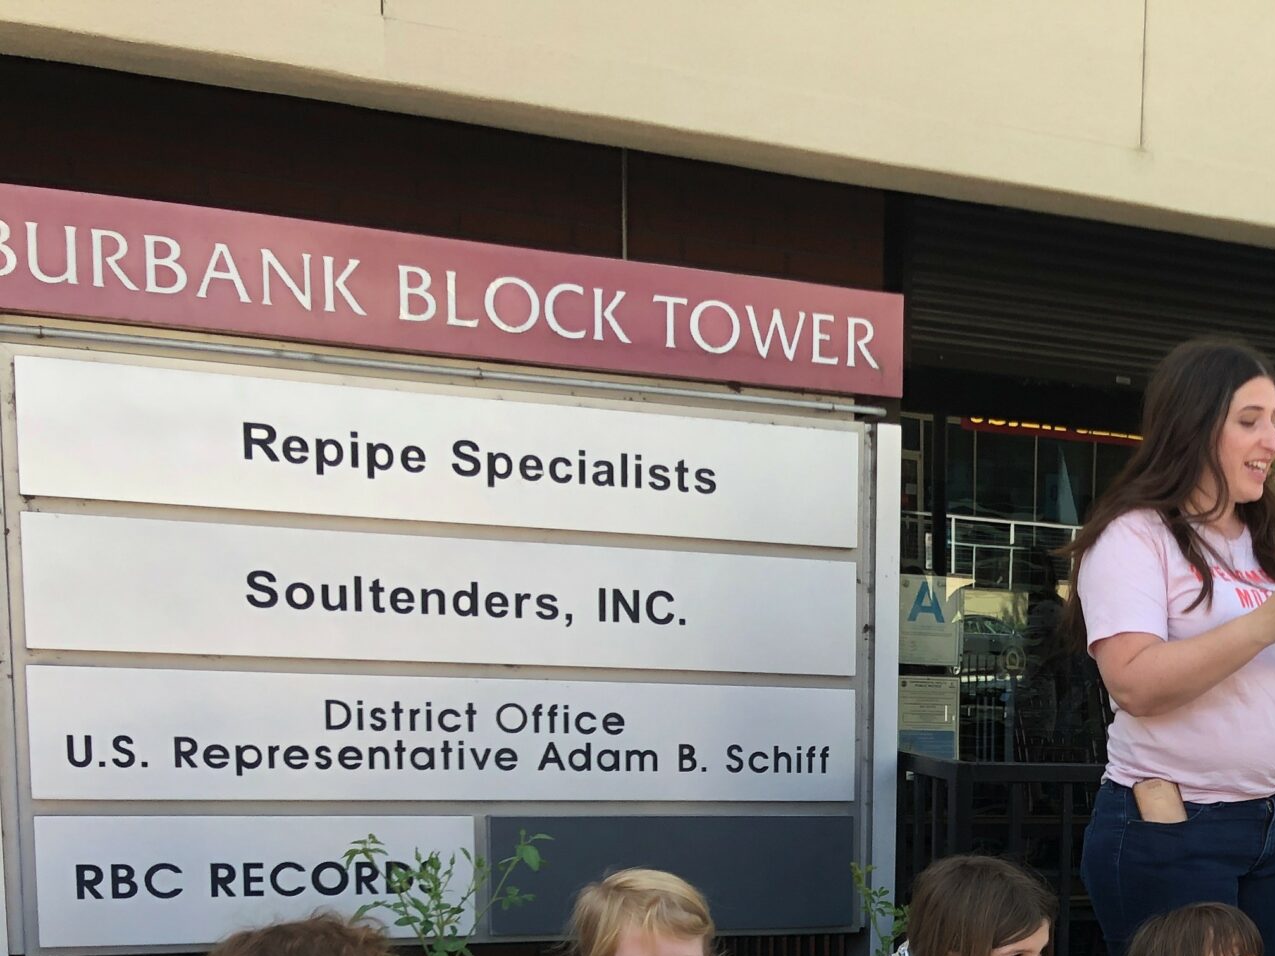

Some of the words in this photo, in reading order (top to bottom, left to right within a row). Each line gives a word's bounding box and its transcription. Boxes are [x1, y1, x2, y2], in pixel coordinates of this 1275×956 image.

[397, 264, 632, 344] BLOCK
[653, 294, 880, 370] TOWER
[242, 422, 426, 479] Repipe
[451, 439, 718, 495] Specialists
[246, 570, 574, 628] Soultenders,
[598, 586, 687, 626] INC.
[907, 581, 945, 623] A
[325, 699, 477, 733] District
[495, 702, 625, 736] Office
[66, 734, 149, 769] U.S.
[173, 736, 519, 777] Representative
[537, 741, 658, 774] Adam
[678, 743, 708, 774] B.
[725, 744, 830, 775] Schiff
[75, 861, 184, 900] RBC
